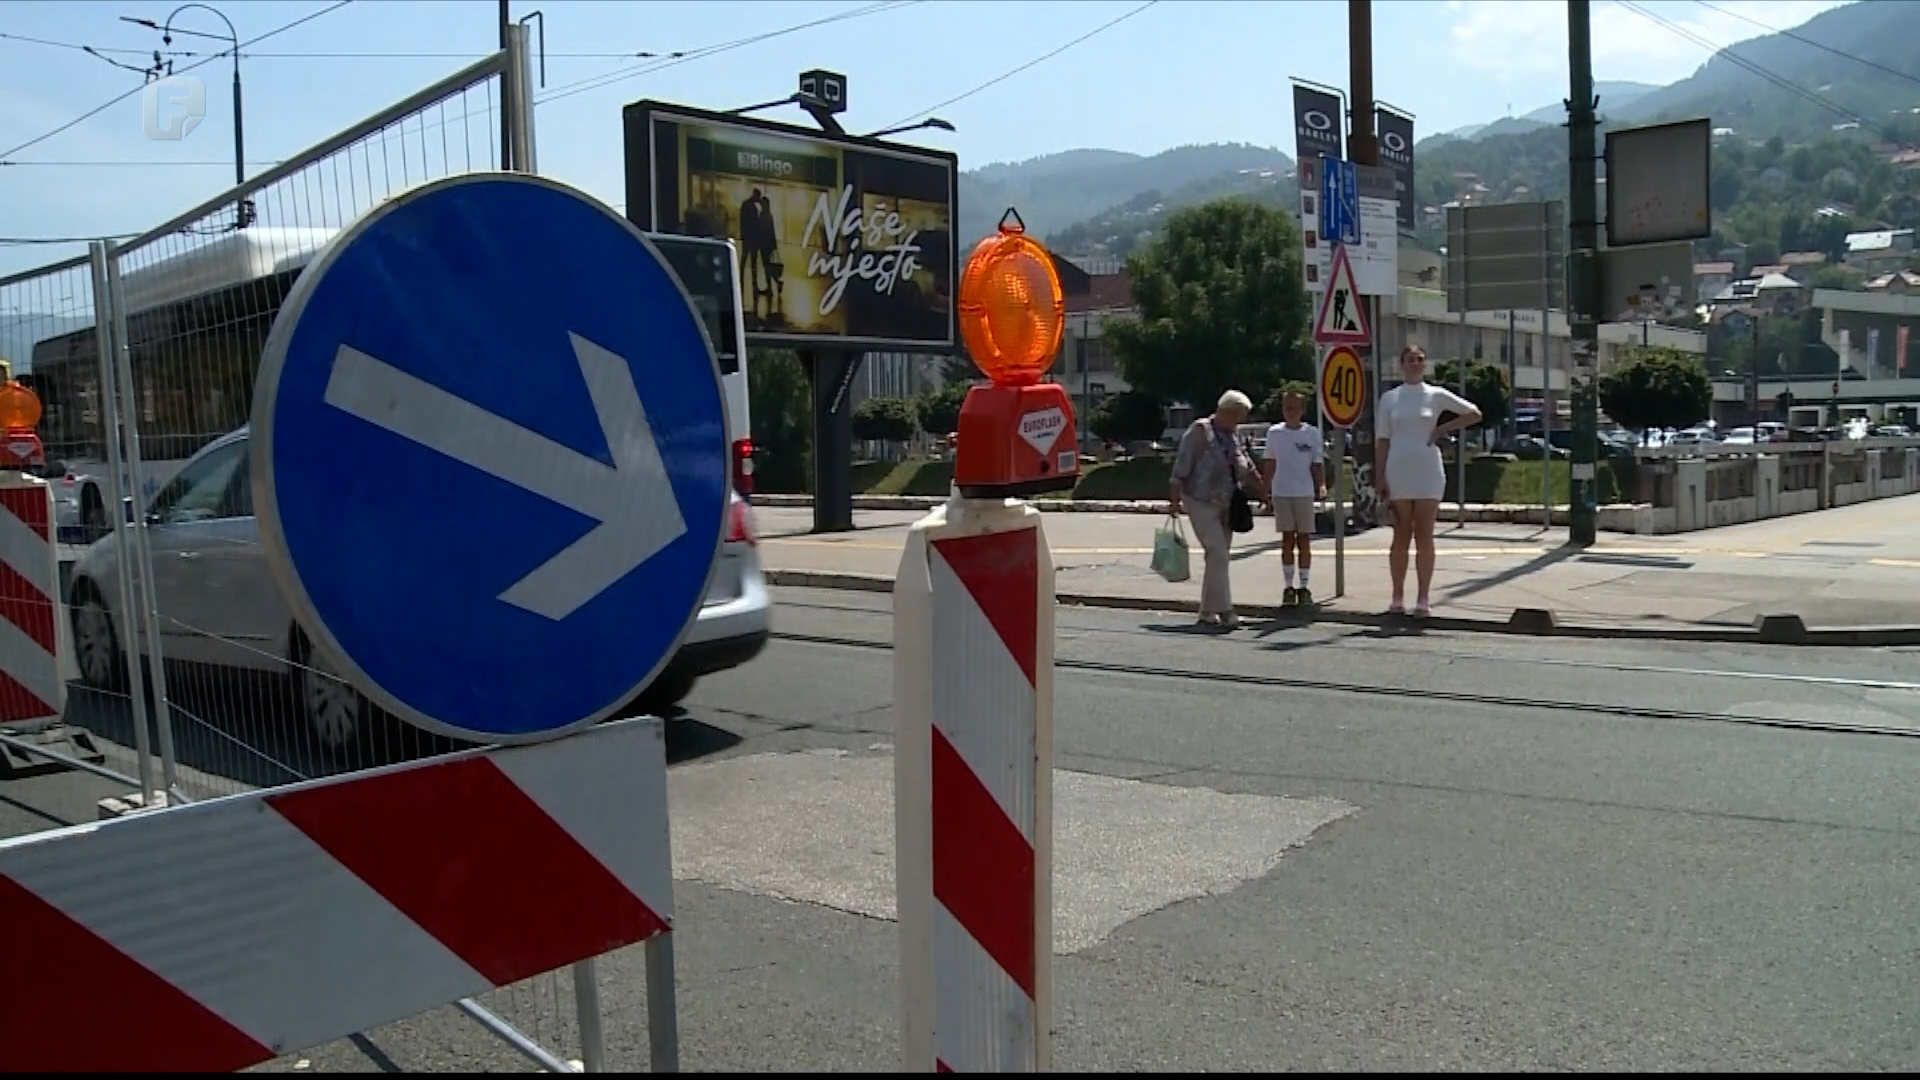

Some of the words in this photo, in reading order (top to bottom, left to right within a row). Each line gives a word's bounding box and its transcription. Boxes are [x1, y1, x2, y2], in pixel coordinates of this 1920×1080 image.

[750, 153, 792, 176] Bingo
[802, 184, 907, 252] Naše
[808, 230, 922, 315] mjesto
[1330, 366, 1357, 407] 40
[1023, 415, 1061, 433] EUROFLASH
